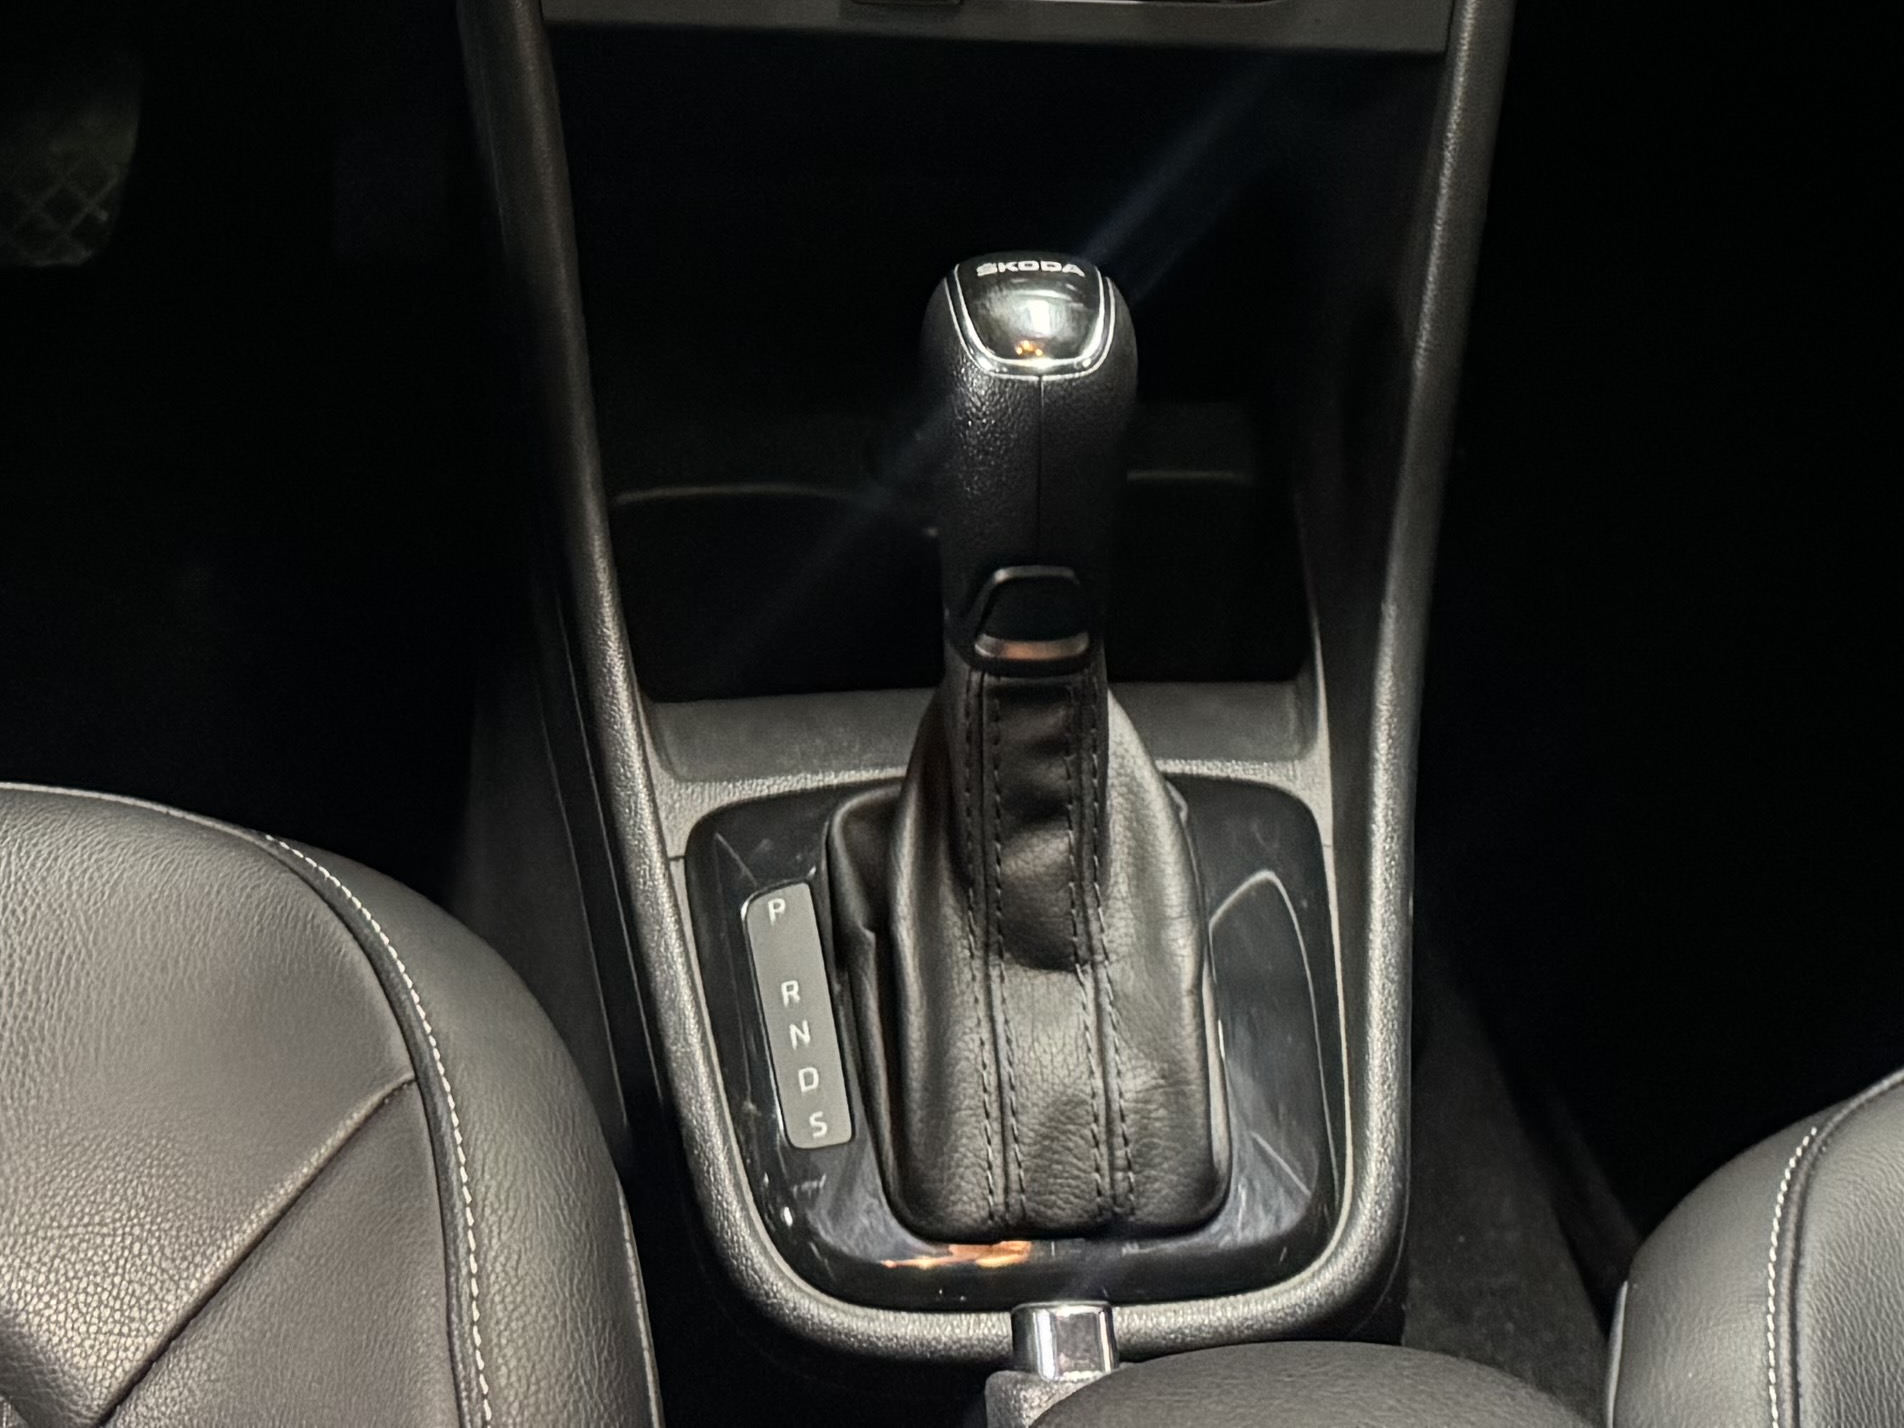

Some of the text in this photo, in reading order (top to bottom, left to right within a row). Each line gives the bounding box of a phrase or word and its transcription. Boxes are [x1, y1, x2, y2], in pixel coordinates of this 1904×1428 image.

[767, 897, 786, 926] P
[781, 979, 801, 1007] R
[789, 1020, 811, 1049] N
[798, 1067, 819, 1093] D
[809, 1111, 827, 1138] S
